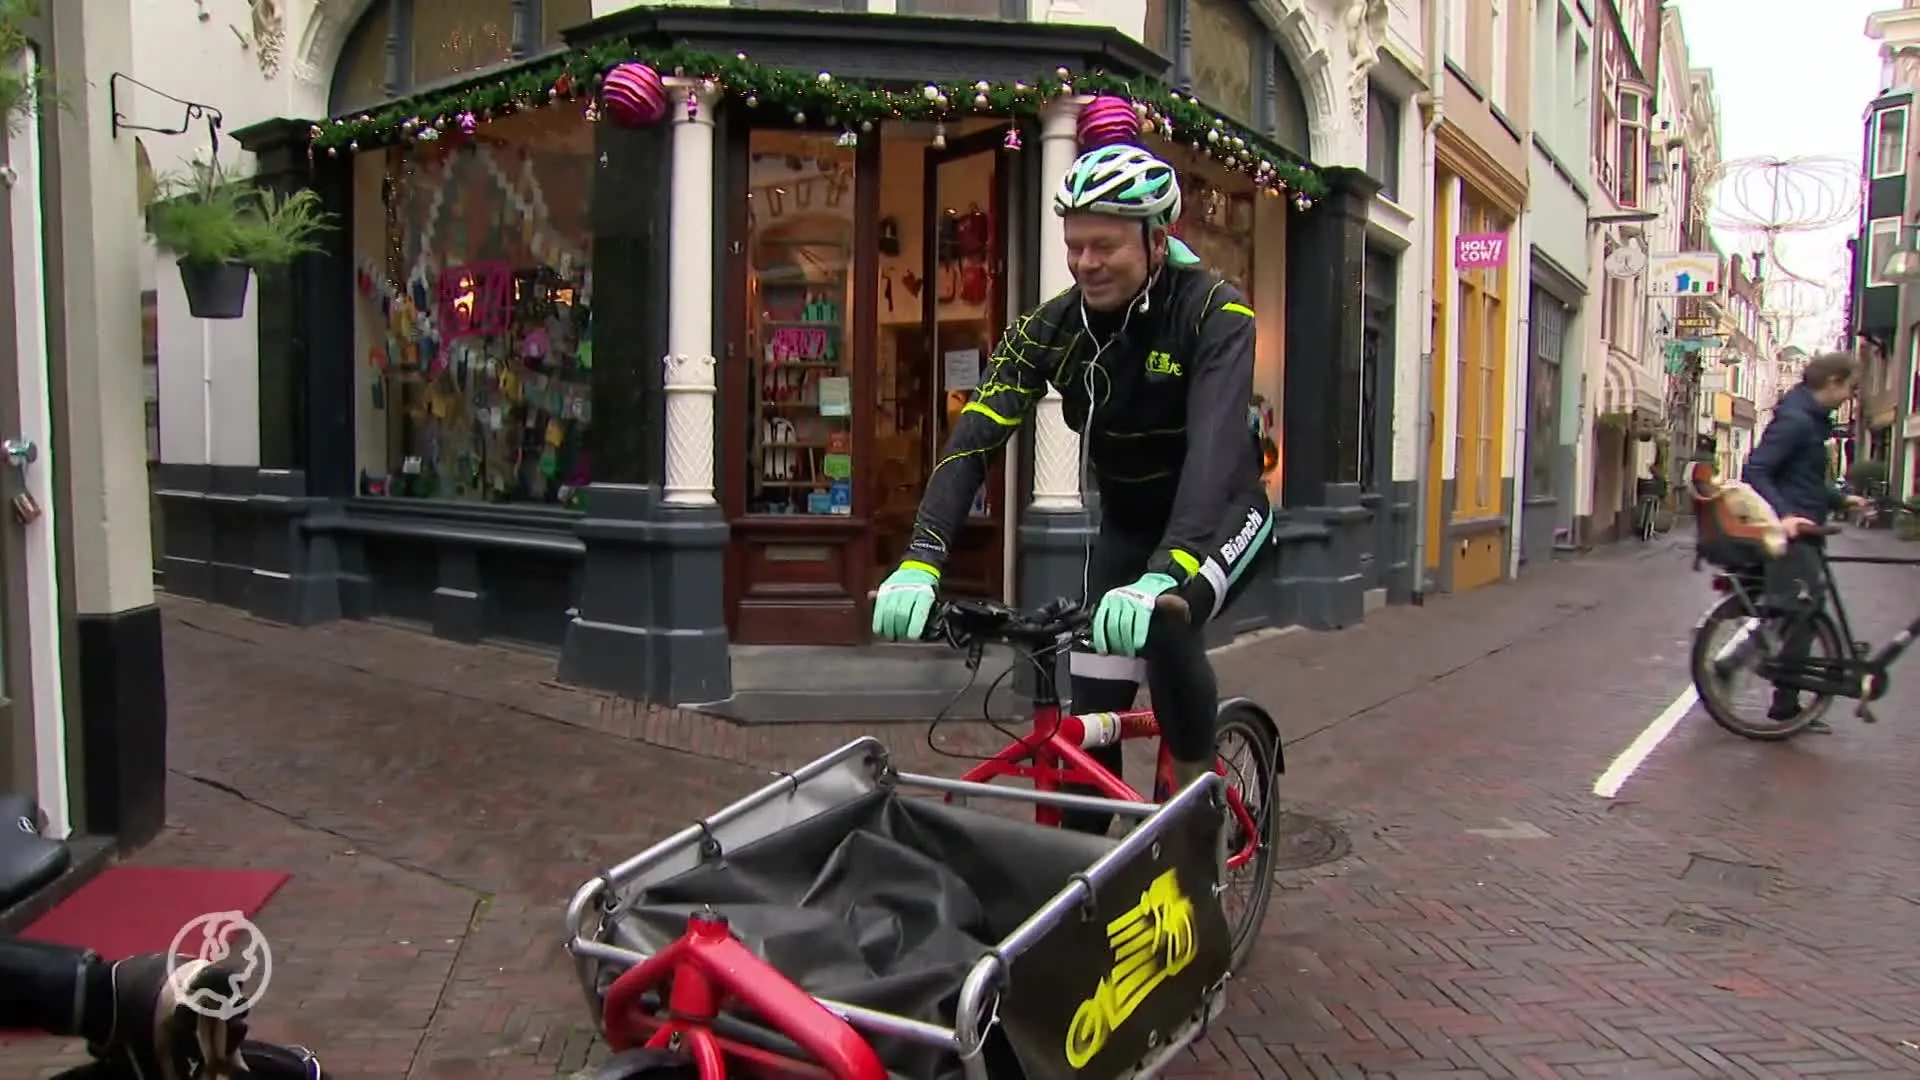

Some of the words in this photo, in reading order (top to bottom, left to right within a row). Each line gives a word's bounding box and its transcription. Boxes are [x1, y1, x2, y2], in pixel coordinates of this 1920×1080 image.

[1460, 240, 1497, 252] HOLY
[1460, 240, 1502, 262] COW!
[1220, 507, 1263, 566] Bianchi
